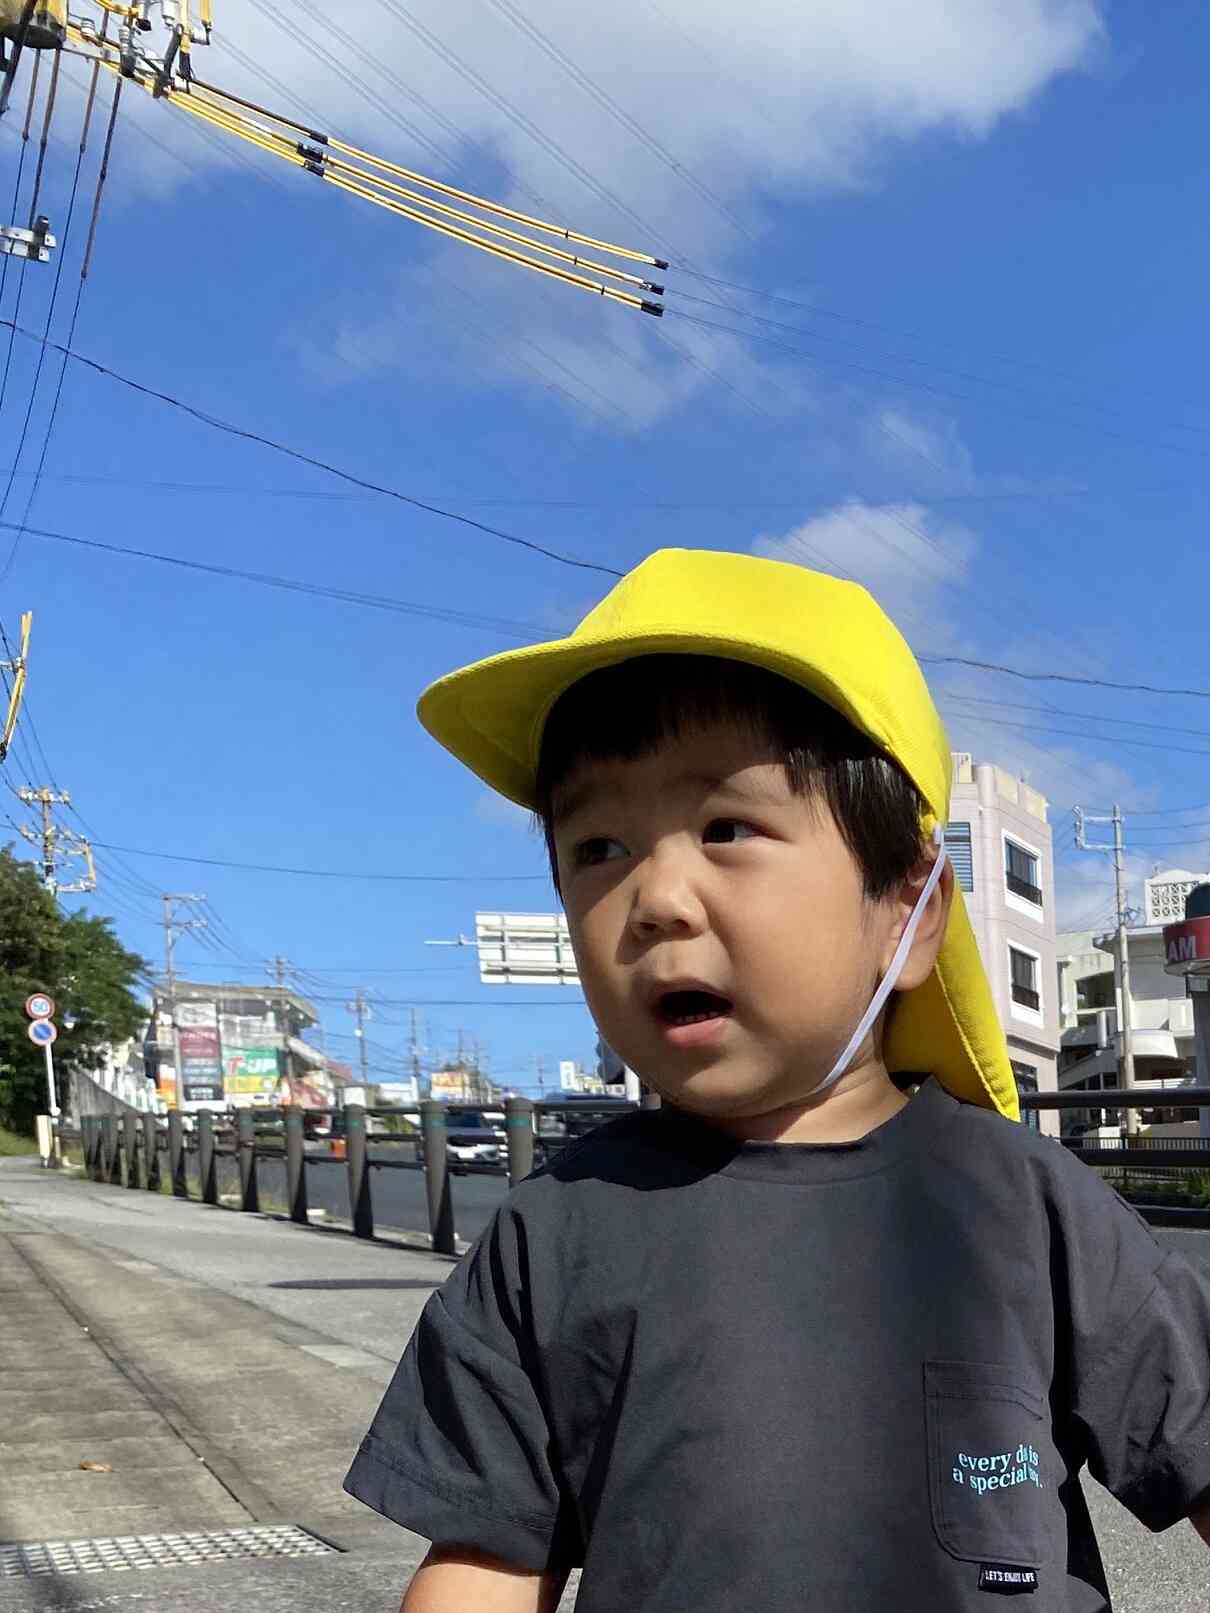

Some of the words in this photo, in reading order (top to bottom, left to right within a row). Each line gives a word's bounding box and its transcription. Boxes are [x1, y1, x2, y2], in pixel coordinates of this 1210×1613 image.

[958, 1452, 1012, 1473] every
[952, 1467, 964, 1484] a
[969, 1463, 1028, 1495] special
